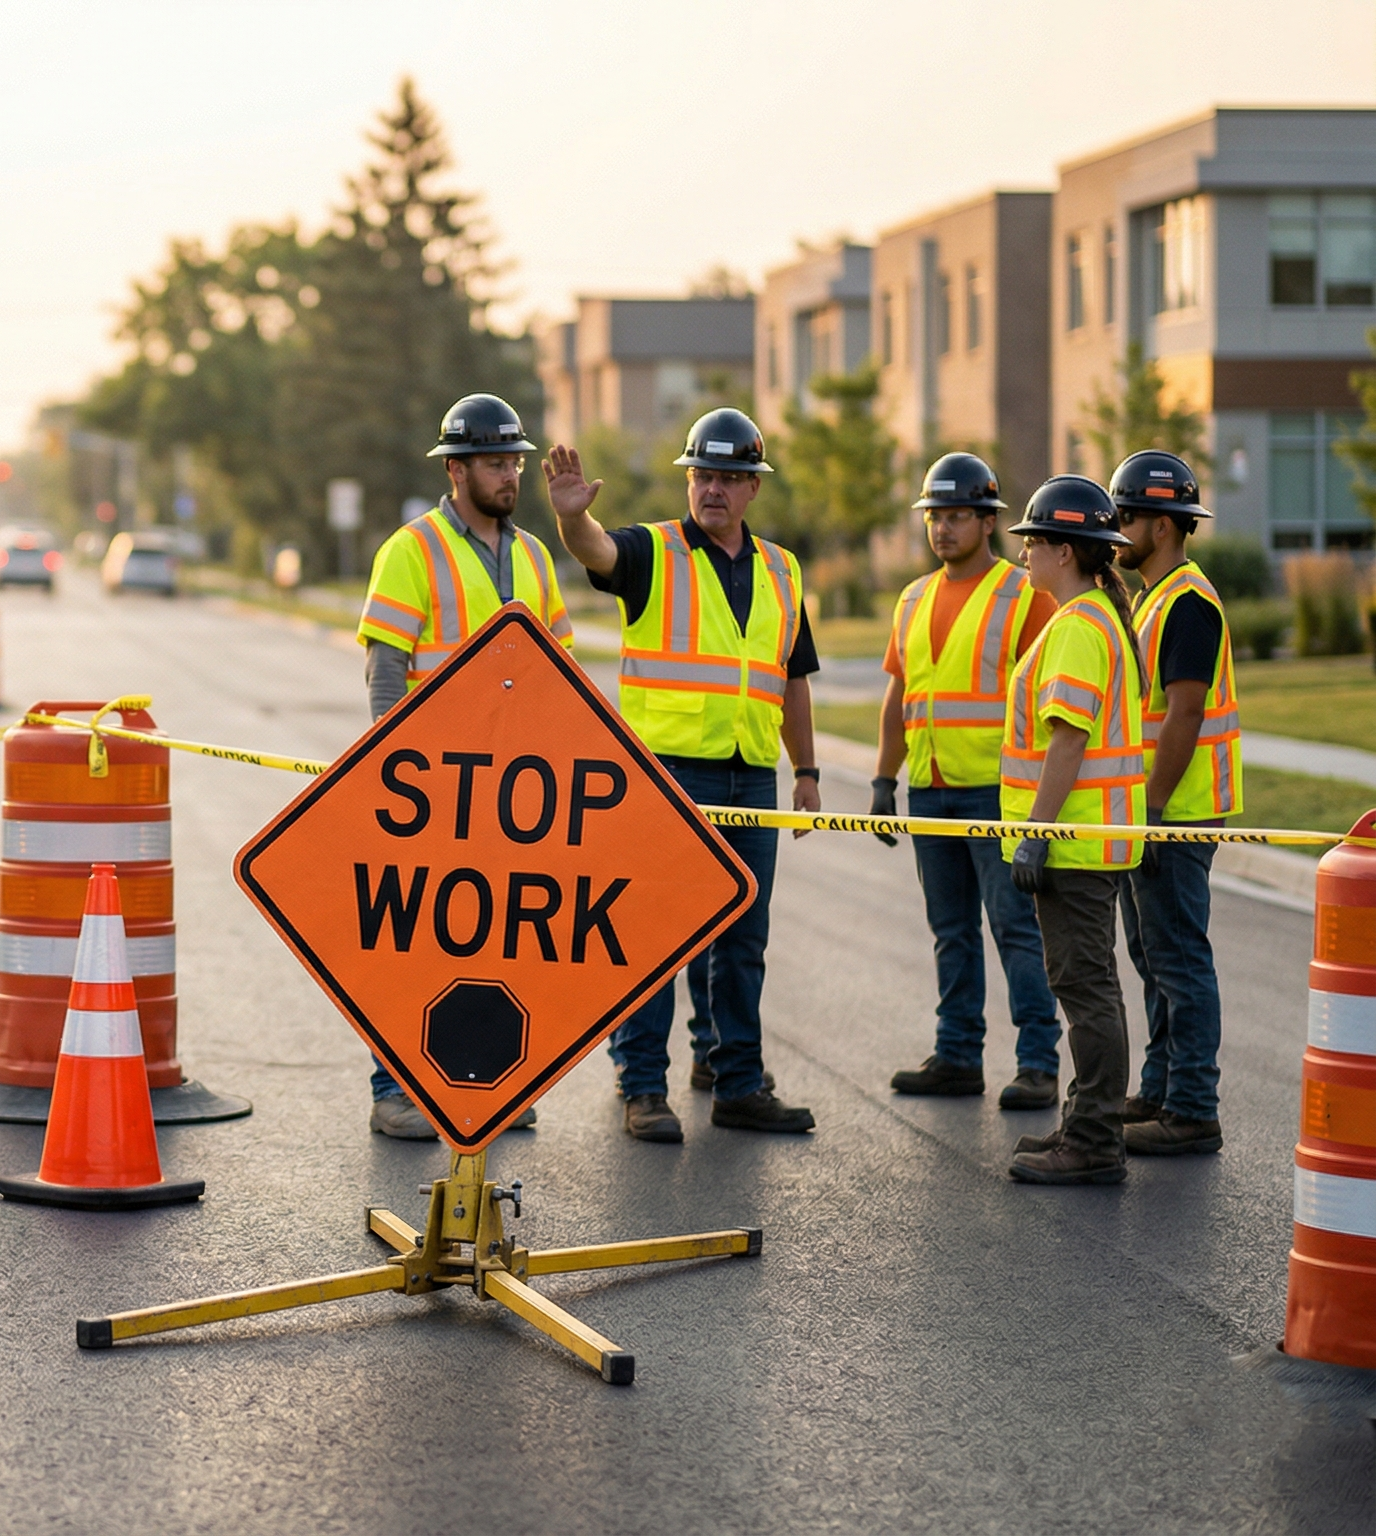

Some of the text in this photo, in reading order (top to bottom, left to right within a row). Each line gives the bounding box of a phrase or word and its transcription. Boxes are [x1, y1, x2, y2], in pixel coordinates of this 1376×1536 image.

[201, 747, 262, 765] CAUTION
[374, 748, 628, 847] STOP
[812, 816, 910, 834] CAUTION
[967, 825, 1078, 840] CAUTION
[353, 862, 632, 967] WORK
